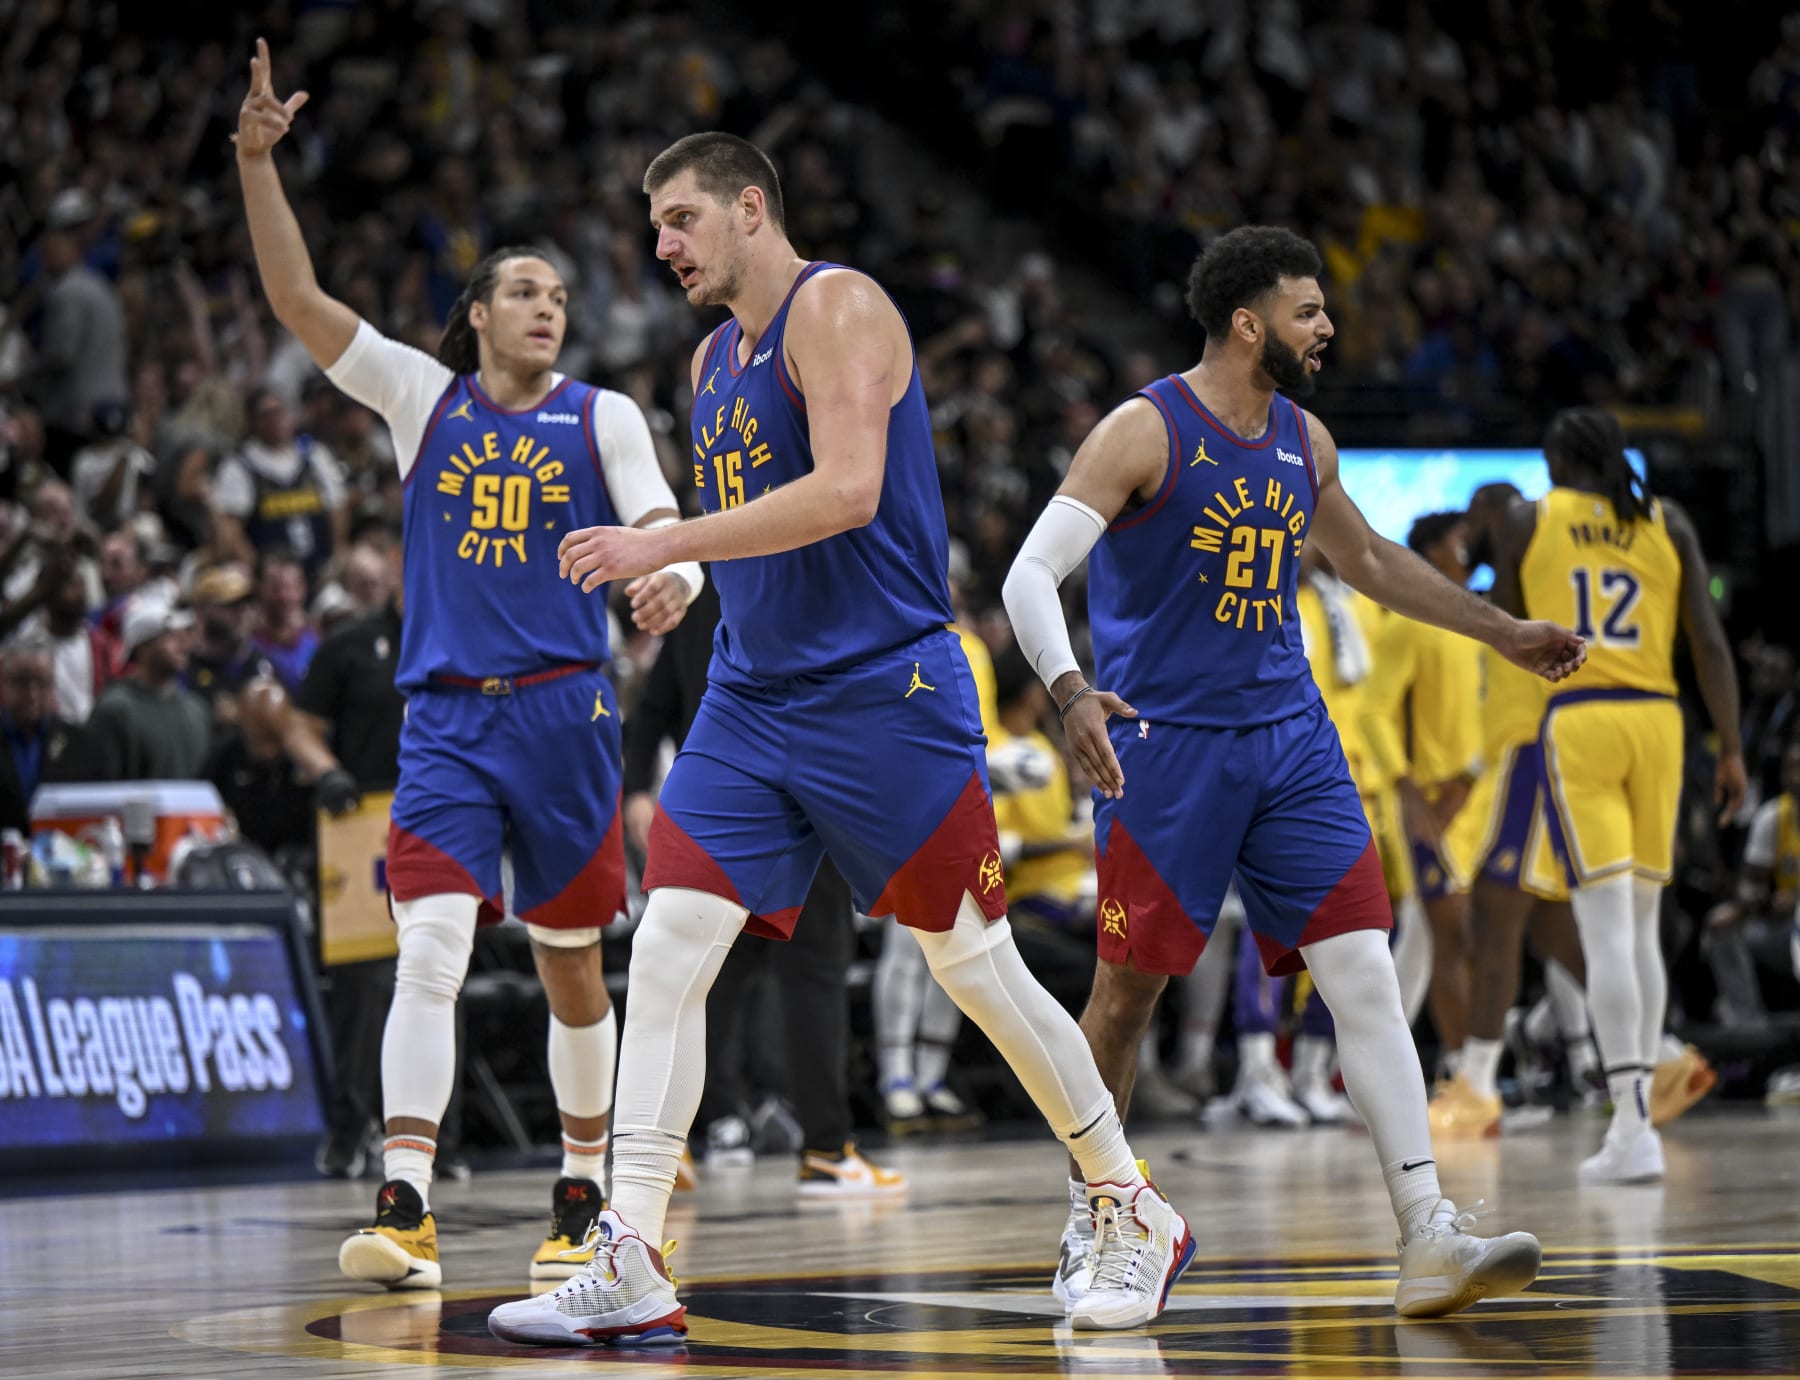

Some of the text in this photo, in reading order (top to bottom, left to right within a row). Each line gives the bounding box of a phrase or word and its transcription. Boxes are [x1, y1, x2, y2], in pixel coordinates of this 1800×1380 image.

[436, 432, 571, 503] MILE HIGH
[694, 396, 773, 488] MILE HIGH
[1276, 447, 1304, 467] ibotta
[471, 474, 532, 532] 50
[713, 450, 745, 512] 15
[1190, 476, 1255, 554] MILE
[456, 530, 528, 569] CITY
[1224, 525, 1286, 591] 27
[1214, 591, 1283, 632] CITY
[1571, 567, 1641, 645] 12
[0, 972, 293, 1119] A League Pass
